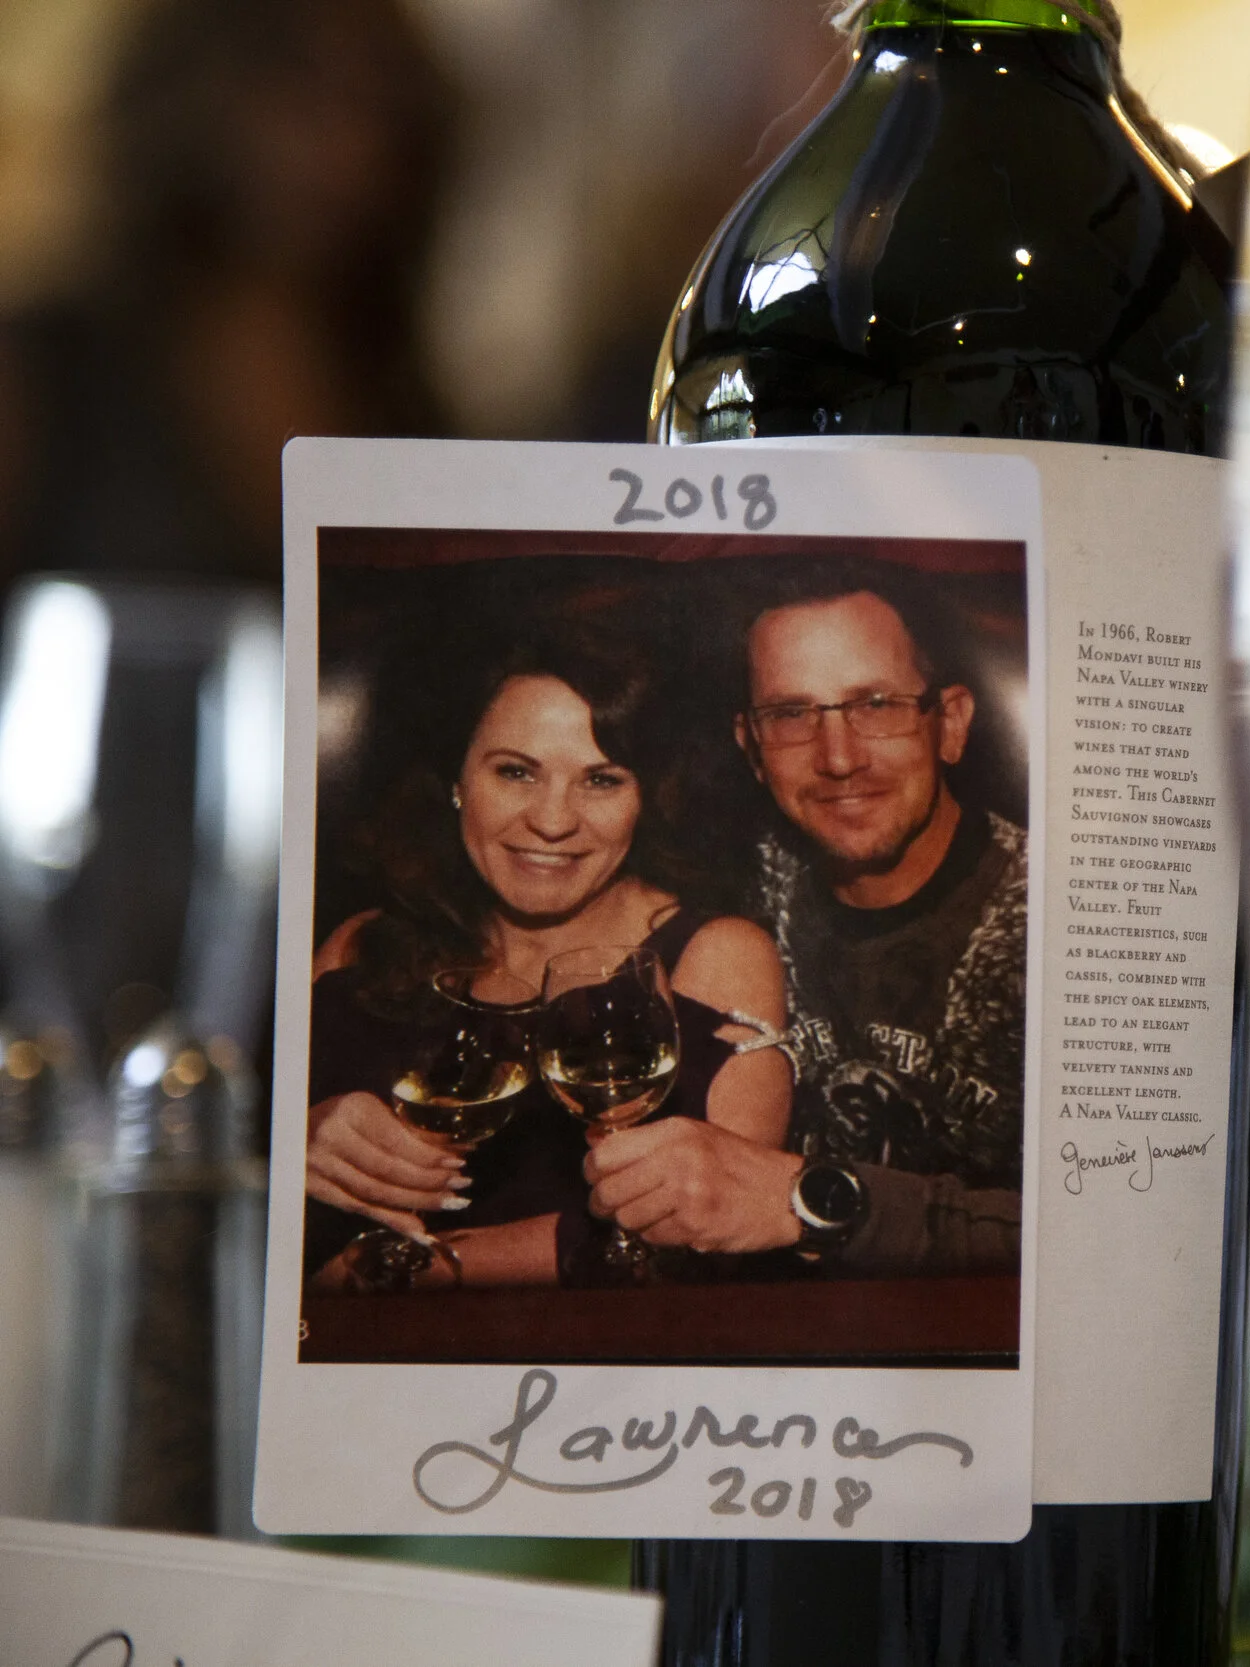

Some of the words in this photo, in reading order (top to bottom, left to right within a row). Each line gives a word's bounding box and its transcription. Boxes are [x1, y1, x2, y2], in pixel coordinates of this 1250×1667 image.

[609, 468, 777, 530] 2018
[1079, 621, 1094, 636] IN
[1102, 623, 1139, 642] 1966,
[1146, 627, 1191, 645] ROBERT
[1078, 644, 1142, 663] MONDAVI
[1148, 655, 1180, 667] BUILT
[1184, 659, 1201, 669] HIS
[1077, 667, 1115, 684] NAPA
[1120, 670, 1165, 688] VALLEY
[1169, 680, 1208, 692] WINERY
[1076, 696, 1110, 707] WITH
[1115, 699, 1123, 708] A
[1128, 699, 1184, 713] SINGULAR
[1075, 719, 1125, 731] VISION:
[1131, 723, 1147, 733] TO
[1152, 724, 1192, 736] CREATE
[1074, 742, 1115, 753] WINES
[1119, 745, 1152, 755] THAT
[1155, 747, 1189, 759] STAND
[1073, 765, 1121, 776] AMONG
[1125, 768, 1149, 778] THE
[1154, 770, 1197, 782] WORLD'S
[1072, 788, 1121, 799] FINEST.
[1127, 785, 1157, 801] THIS
[1162, 787, 1215, 807] CABERNET
[1072, 804, 1148, 824] SAUVIGNON
[1153, 816, 1211, 829] SHOWCASES
[1071, 833, 1158, 847] OUTSTANDING
[1163, 839, 1216, 852] VINEYARDS
[1071, 856, 1084, 865] IN
[1090, 857, 1115, 867] THE
[1120, 859, 1191, 872] GEOGRAPHIC
[1069, 879, 1118, 890] CENTER
[1123, 882, 1139, 891] OF
[1142, 883, 1164, 893] THE
[1169, 879, 1197, 896] NAPA
[1068, 896, 1121, 913] VALLEY.
[1128, 899, 1162, 915] FRUIT
[1068, 925, 1178, 942] CHARACTERISTICS,
[1183, 931, 1207, 941] SUCH
[1066, 948, 1081, 957] AS
[1087, 949, 1161, 961] BLACKBERRY
[1165, 953, 1186, 962] AND
[1066, 971, 1112, 983] CASSIS,
[1118, 973, 1177, 984] COMBINED
[1181, 976, 1205, 987] WITH
[1064, 993, 1090, 1004] THE
[1095, 995, 1128, 1005] SPICY
[1132, 996, 1155, 1006] OAK
[1158, 998, 1209, 1011] ELEMENTS,
[1064, 1017, 1096, 1027] LEAD
[1101, 1018, 1117, 1028] TO
[1122, 1019, 1137, 1028] AN
[1142, 1020, 1189, 1031] ELEGANT
[1063, 1040, 1137, 1053] STRUCTURE,
[1143, 1043, 1171, 1053] WITH
[1062, 1063, 1116, 1073] VELVETY
[1120, 1065, 1169, 1075] TANNINS
[1172, 1067, 1193, 1076] AND
[1062, 1085, 1132, 1097] EXCELLENT
[1135, 1088, 1181, 1099] LENGTH.
[1059, 1103, 1072, 1118] A
[1077, 1103, 1112, 1119] NAPA
[1116, 1104, 1158, 1120] VALLEY
[1161, 1112, 1201, 1122] CLASSIC.
[707, 1466, 873, 1528] 2018
